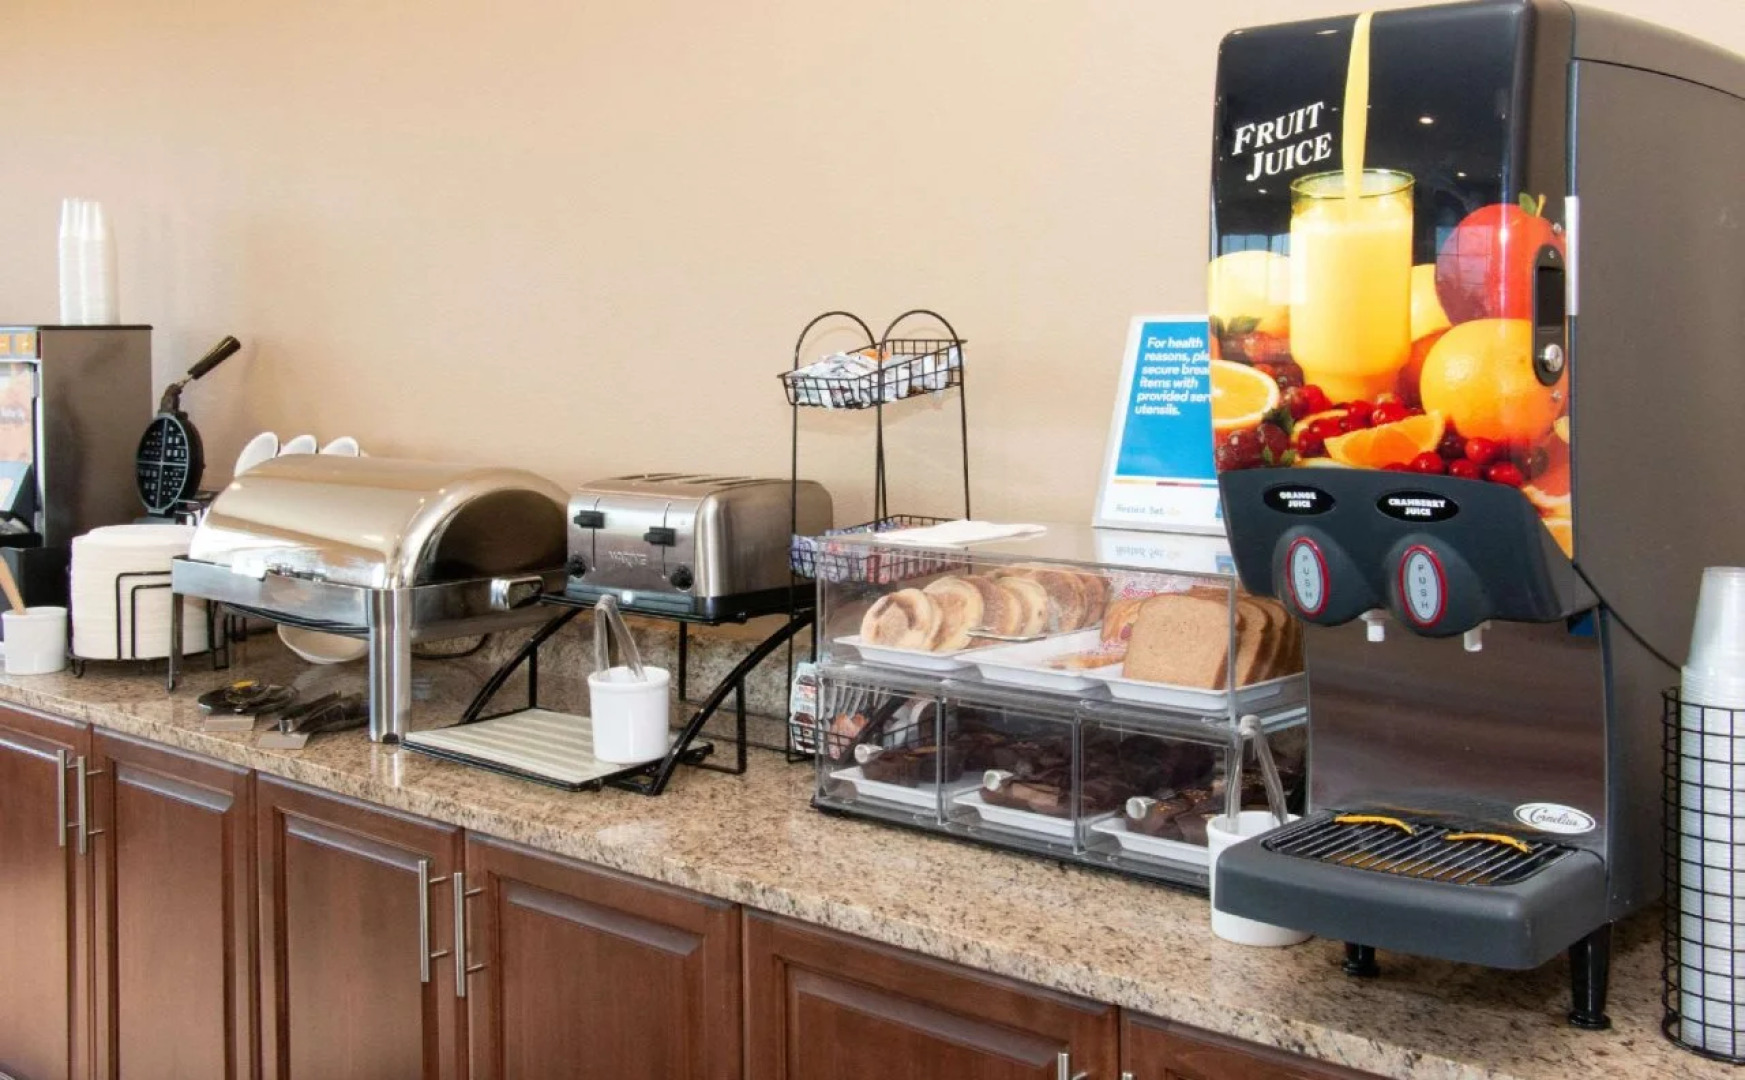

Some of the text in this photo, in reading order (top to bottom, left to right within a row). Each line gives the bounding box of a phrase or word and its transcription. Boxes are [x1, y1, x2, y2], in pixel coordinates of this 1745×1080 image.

[1231, 101, 1325, 156] FRUIT
[1245, 132, 1333, 182] JUICE
[1147, 336, 1203, 349] For health
[1144, 352, 1190, 364] reasons,
[1141, 366, 1180, 375] secure
[1140, 375, 1199, 389] items with
[1136, 389, 1189, 403] provided
[1134, 403, 1181, 416] utensils.
[1279, 491, 1317, 500] ORANGE
[1287, 500, 1312, 508] JUICE
[1388, 498, 1446, 508] CRANBERRY
[1404, 507, 1432, 516] JUICE
[1302, 554, 1313, 599] PUSH
[1417, 563, 1428, 609] PUSH
